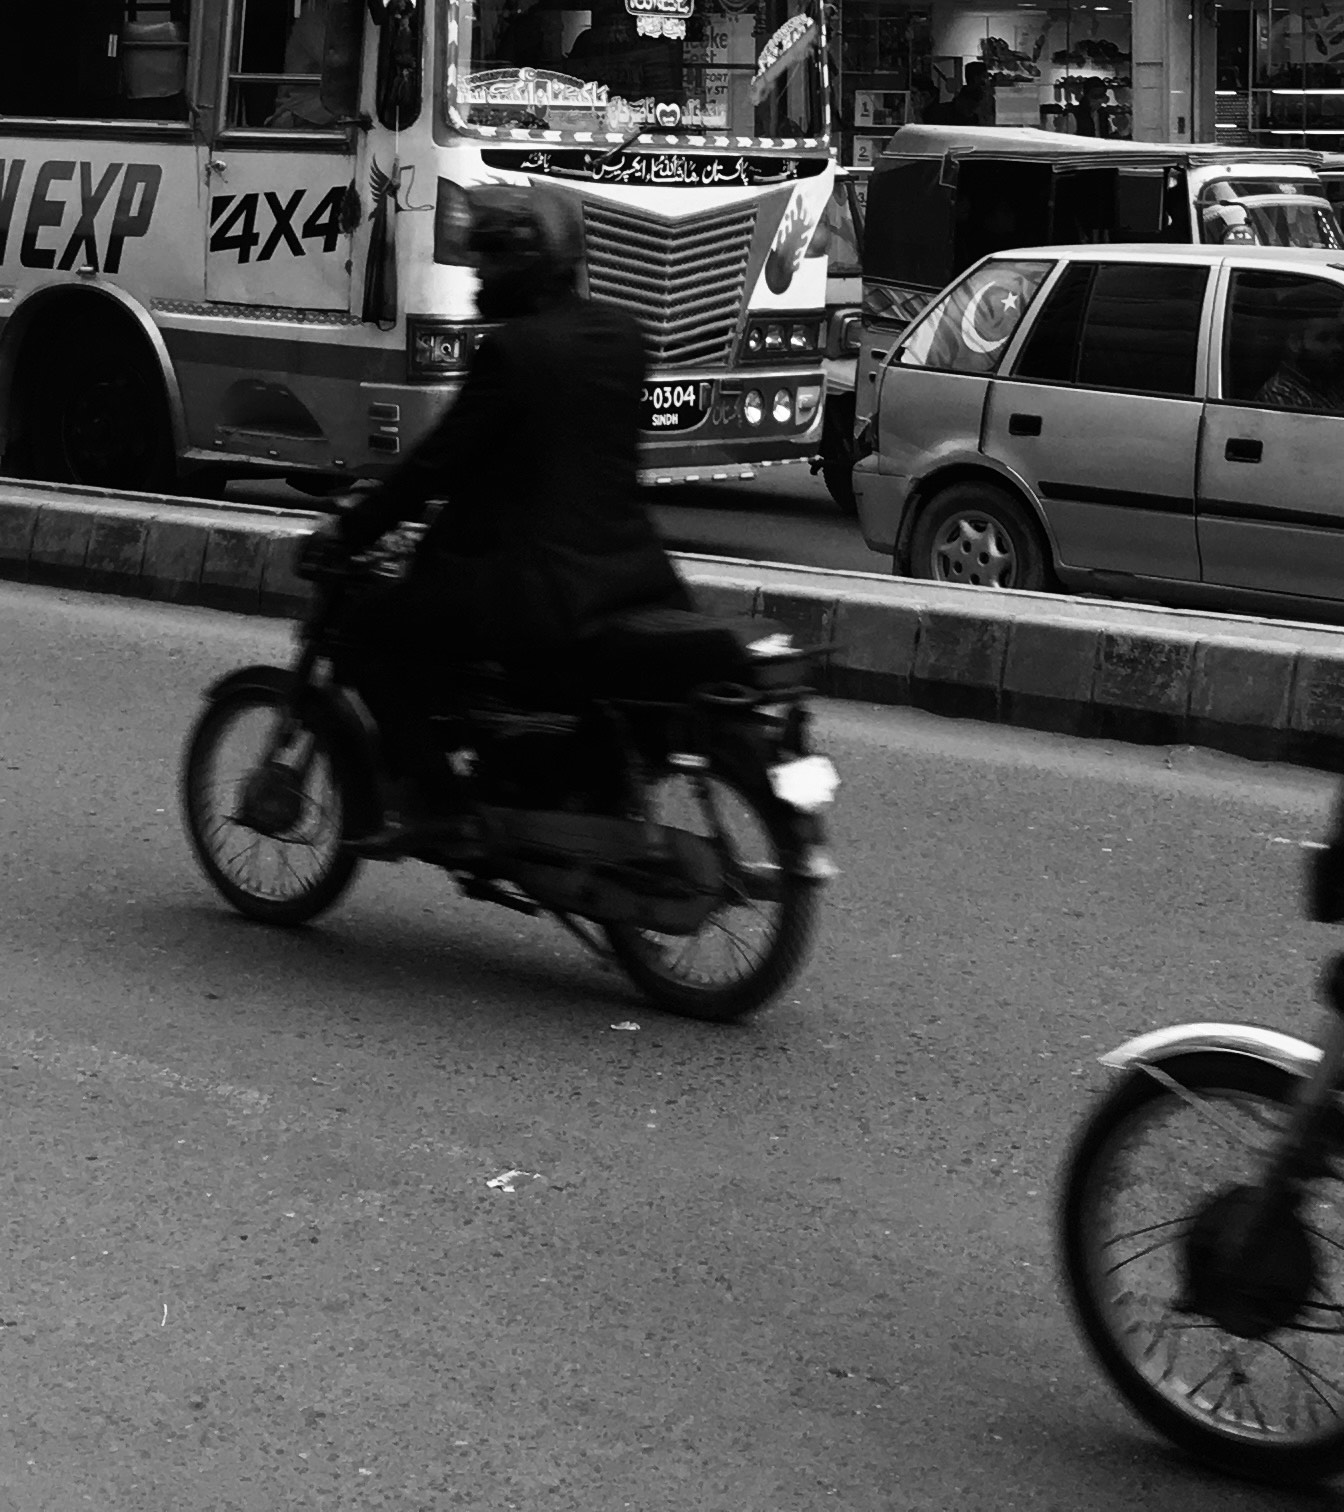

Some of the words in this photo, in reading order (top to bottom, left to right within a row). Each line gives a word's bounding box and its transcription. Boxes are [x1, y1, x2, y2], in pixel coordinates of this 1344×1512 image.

[20, 160, 163, 275] EXP
[209, 185, 349, 264] 4X4
[652, 413, 679, 426] SINDH
